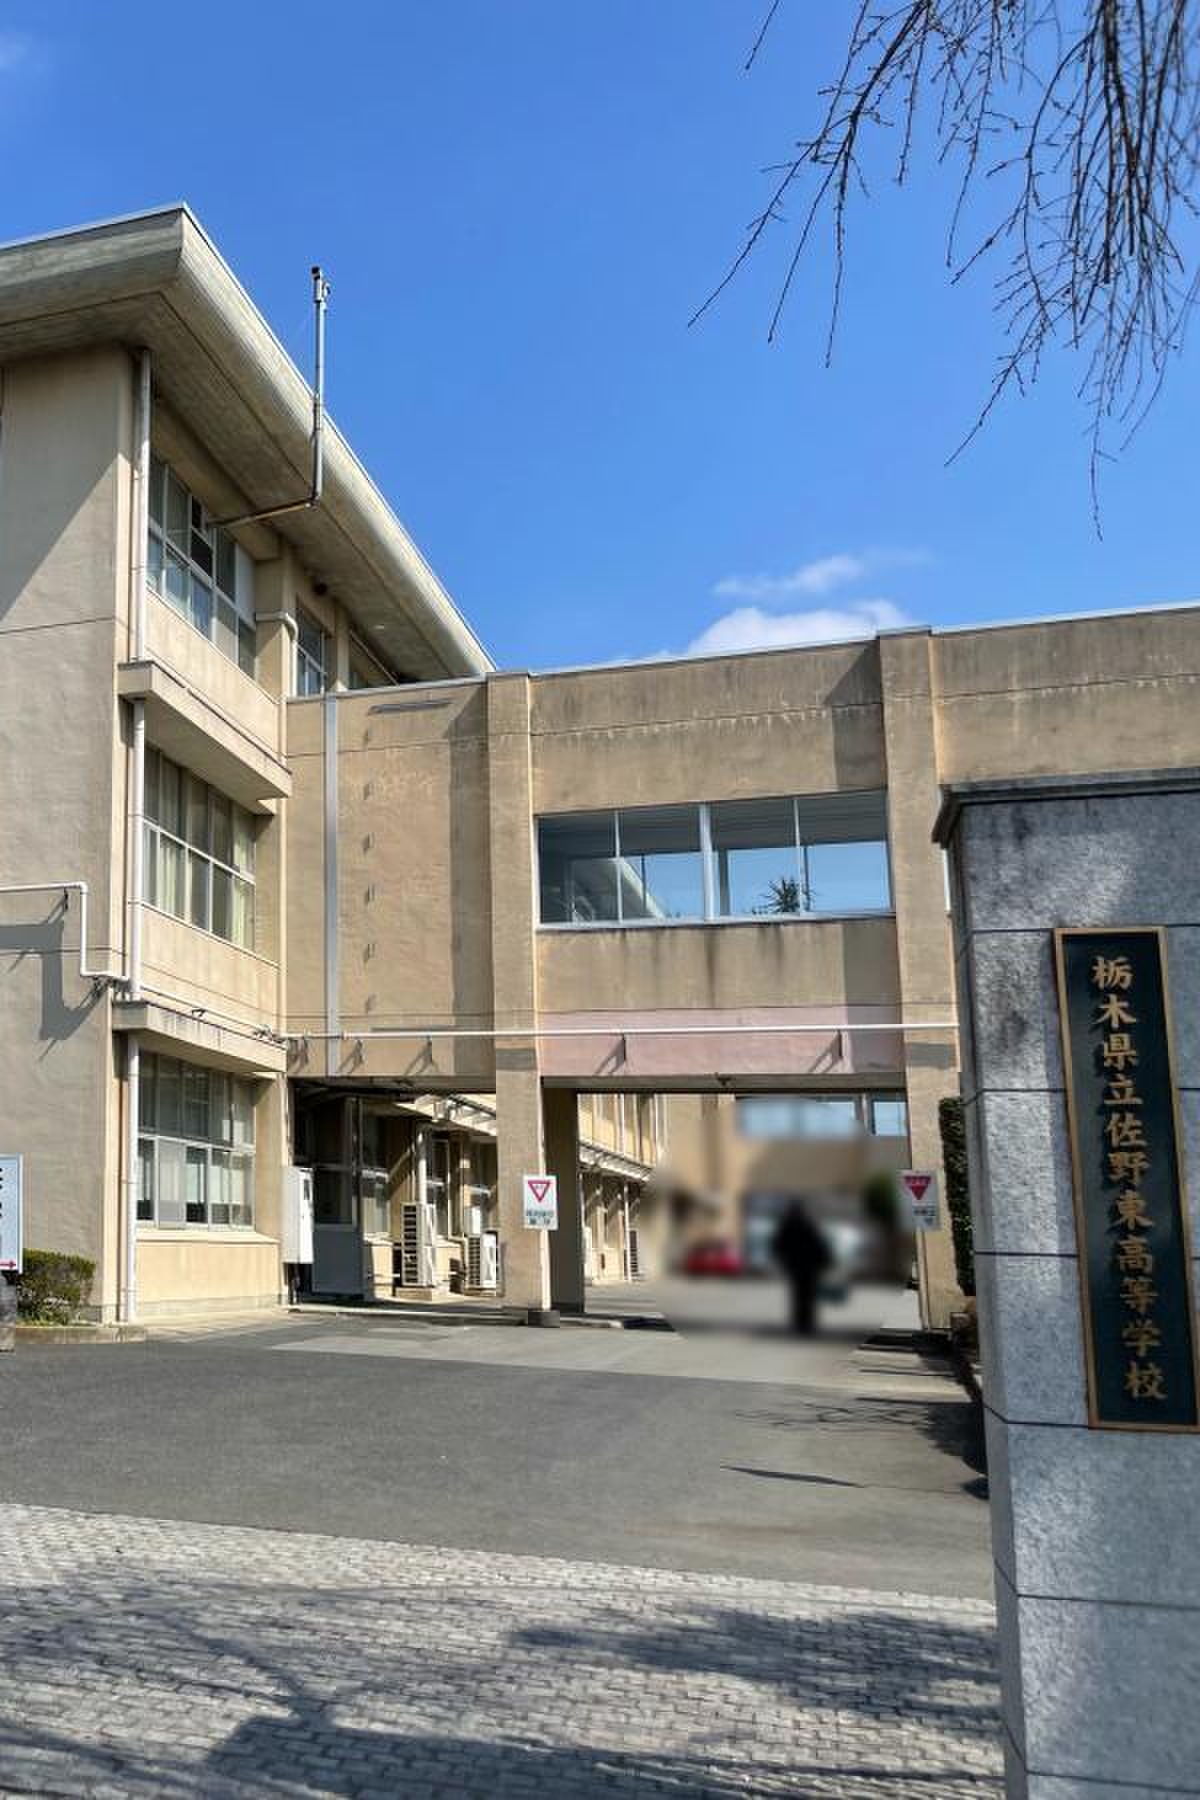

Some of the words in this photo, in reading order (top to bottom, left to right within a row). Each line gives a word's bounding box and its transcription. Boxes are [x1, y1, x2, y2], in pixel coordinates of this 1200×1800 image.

[1091, 956, 1168, 1400] 栃木県立佐野東高等学校
